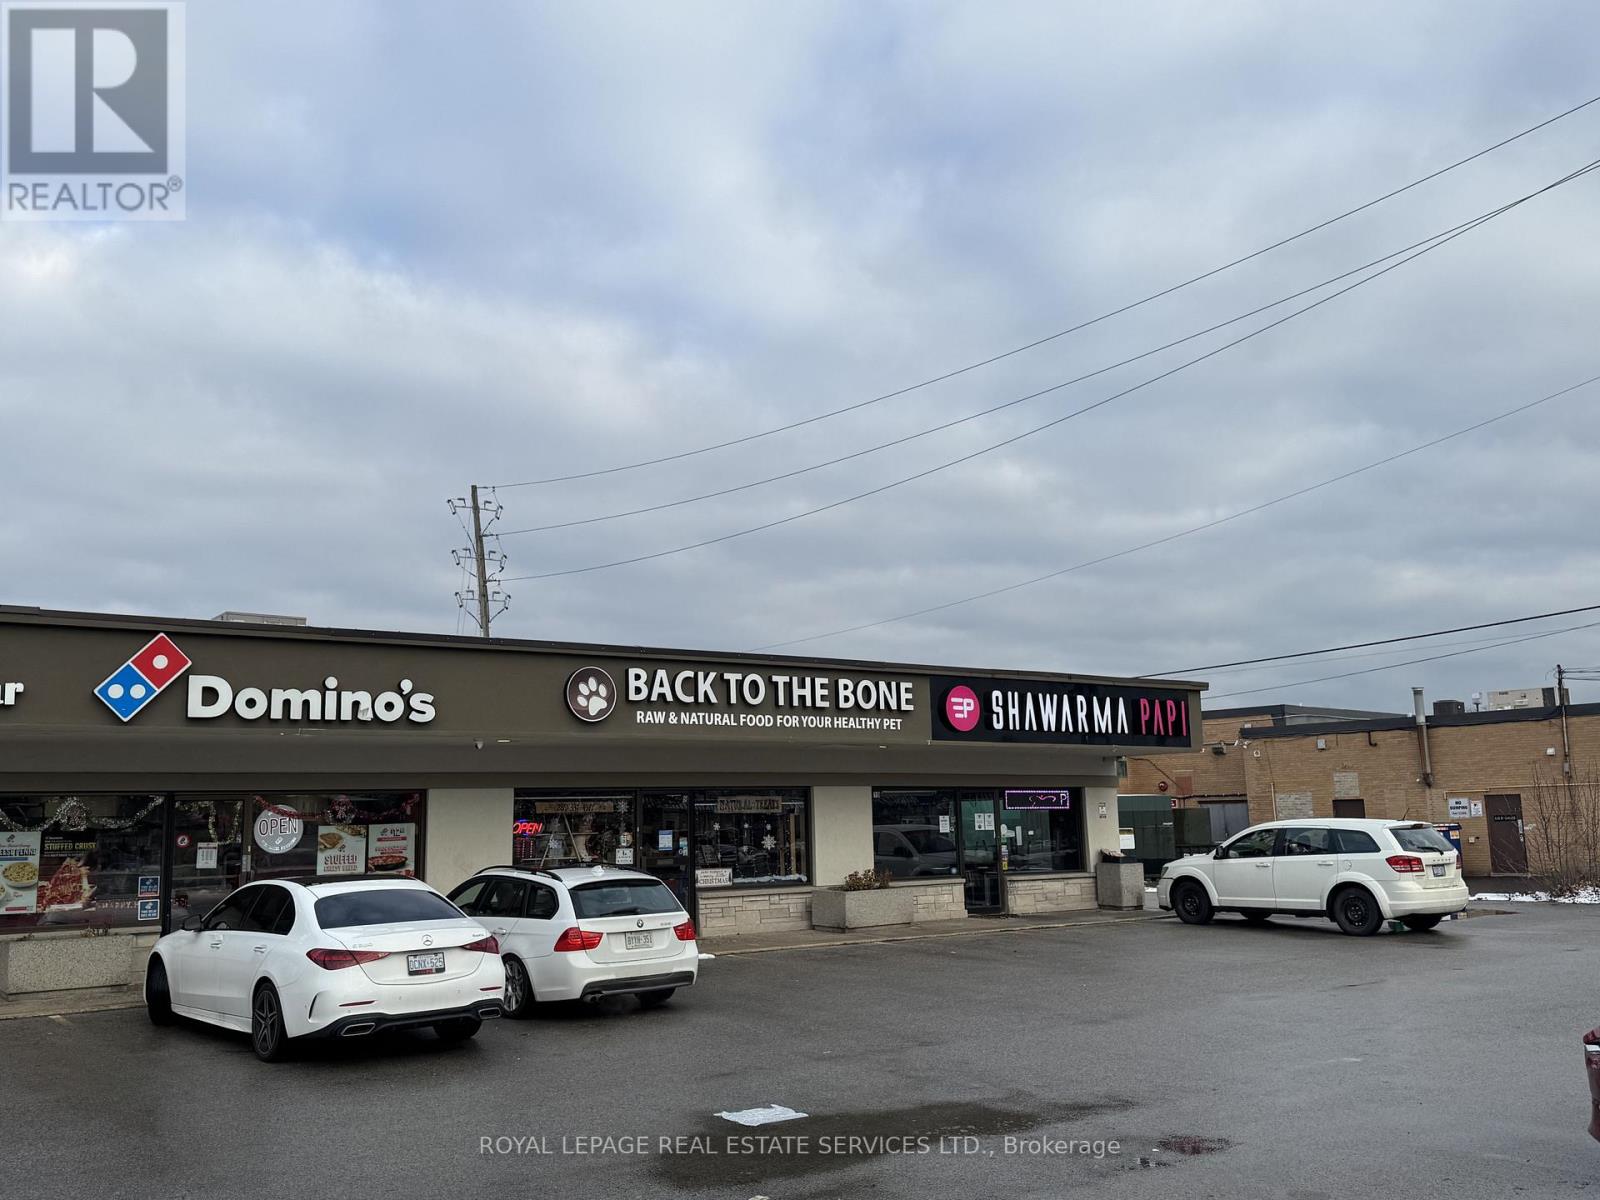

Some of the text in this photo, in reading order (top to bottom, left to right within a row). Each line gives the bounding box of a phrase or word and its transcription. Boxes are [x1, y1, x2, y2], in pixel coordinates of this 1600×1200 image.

[0, 682, 24, 705] r
[187, 676, 436, 723] Domino's
[628, 667, 914, 711] BACK TO THE BONE
[636, 710, 902, 731] RAW & NATURAL FOOD FOR YOUR HEALTHY PET
[991, 690, 1187, 737] SHAWARMA PAPI
[258, 816, 298, 837] OPEN
[512, 822, 543, 834] OPEN
